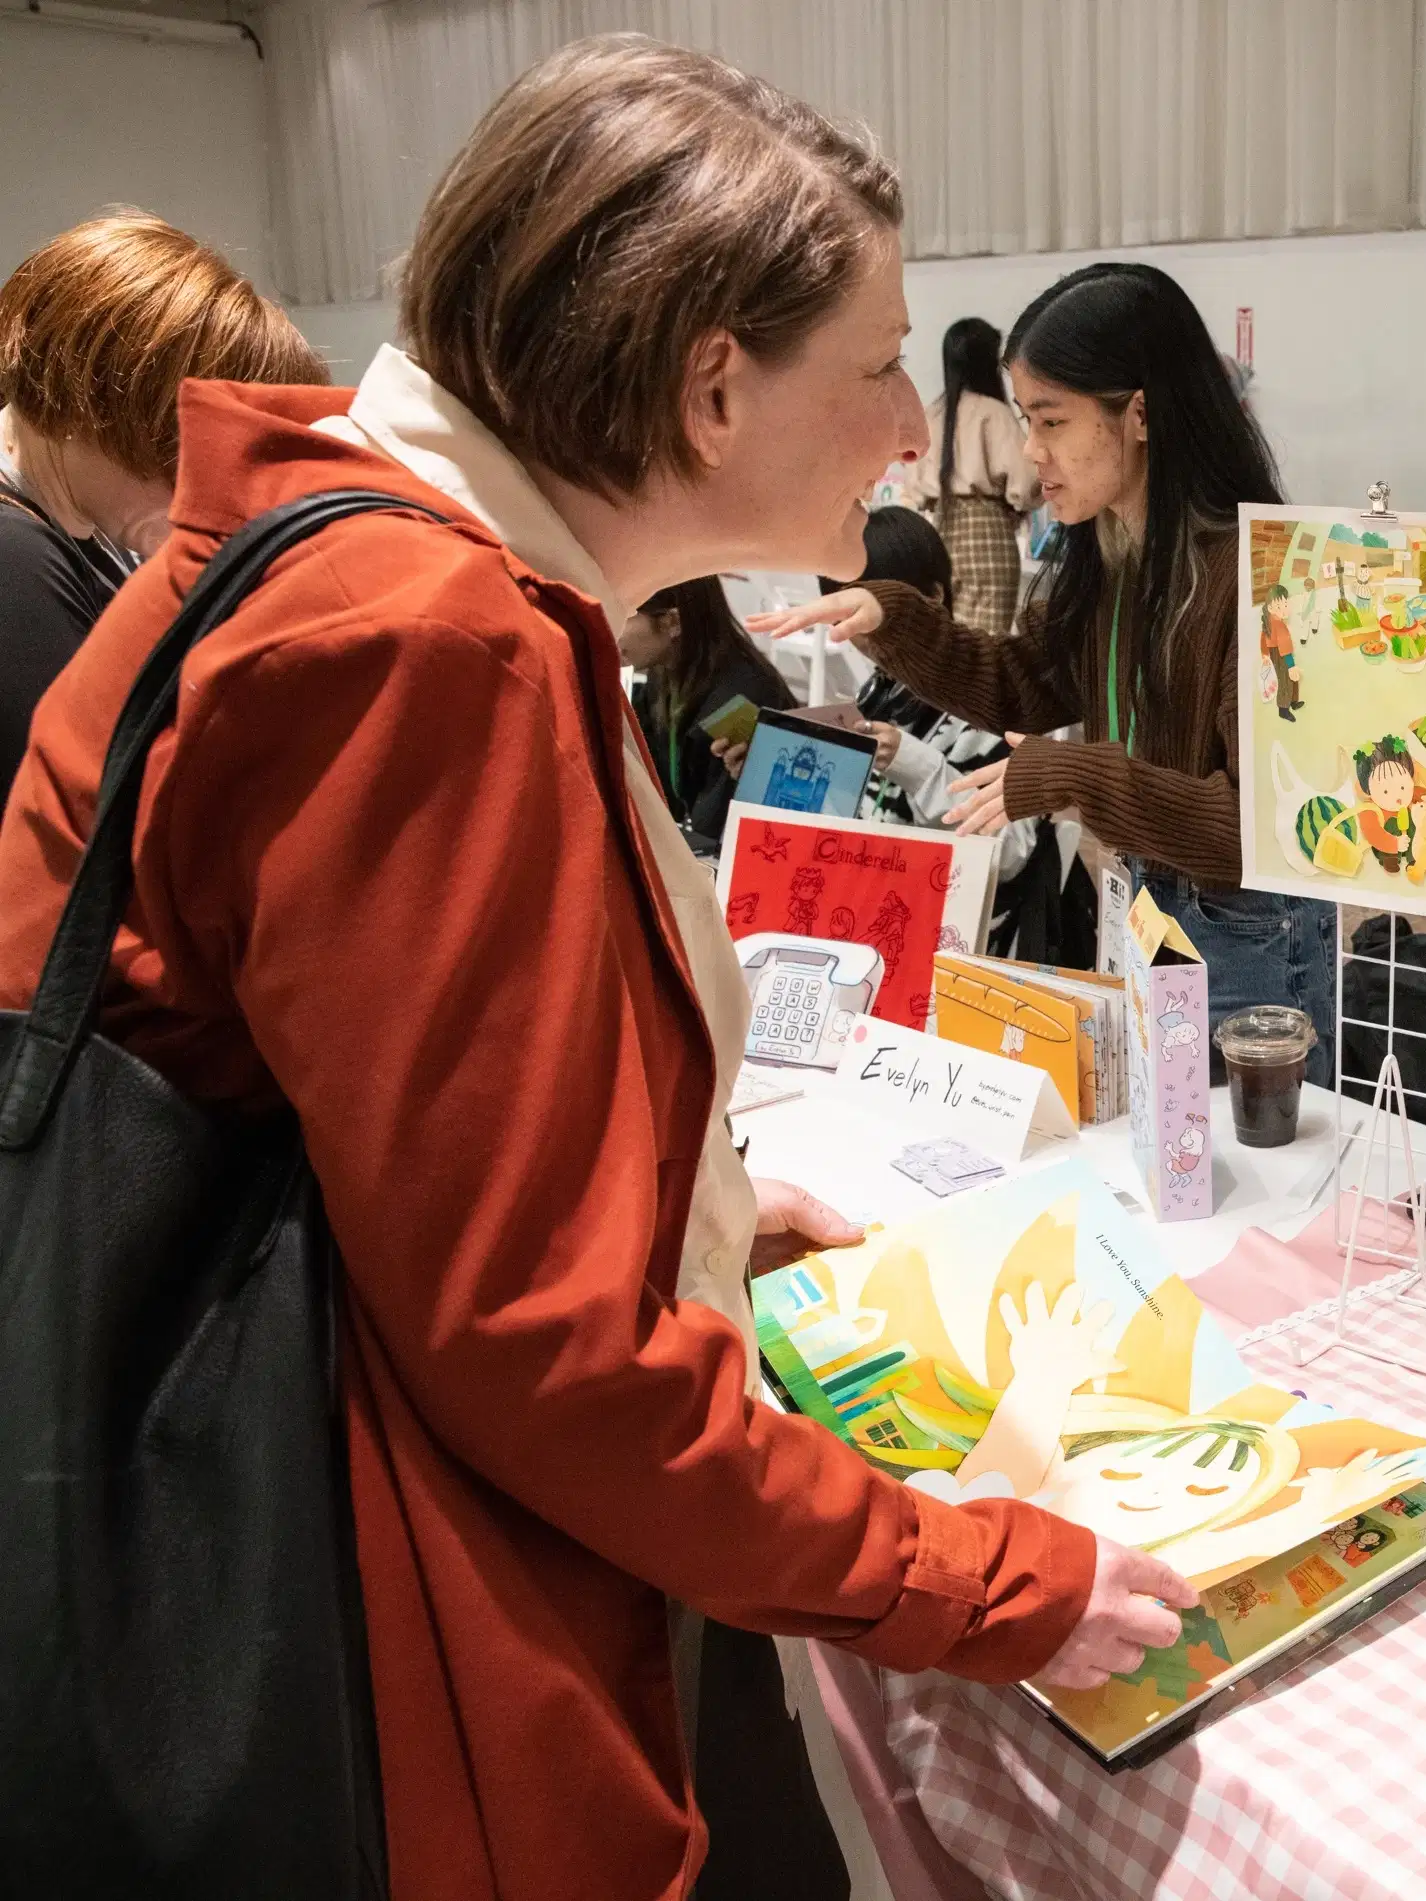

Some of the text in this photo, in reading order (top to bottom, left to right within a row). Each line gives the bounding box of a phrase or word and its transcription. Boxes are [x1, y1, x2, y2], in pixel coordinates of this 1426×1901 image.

[818, 837, 907, 873] Cinderella
[861, 1047, 962, 1107] Evelyn Yu
[1099, 1239, 1119, 1260] Love
[1116, 1260, 1132, 1280] You,
